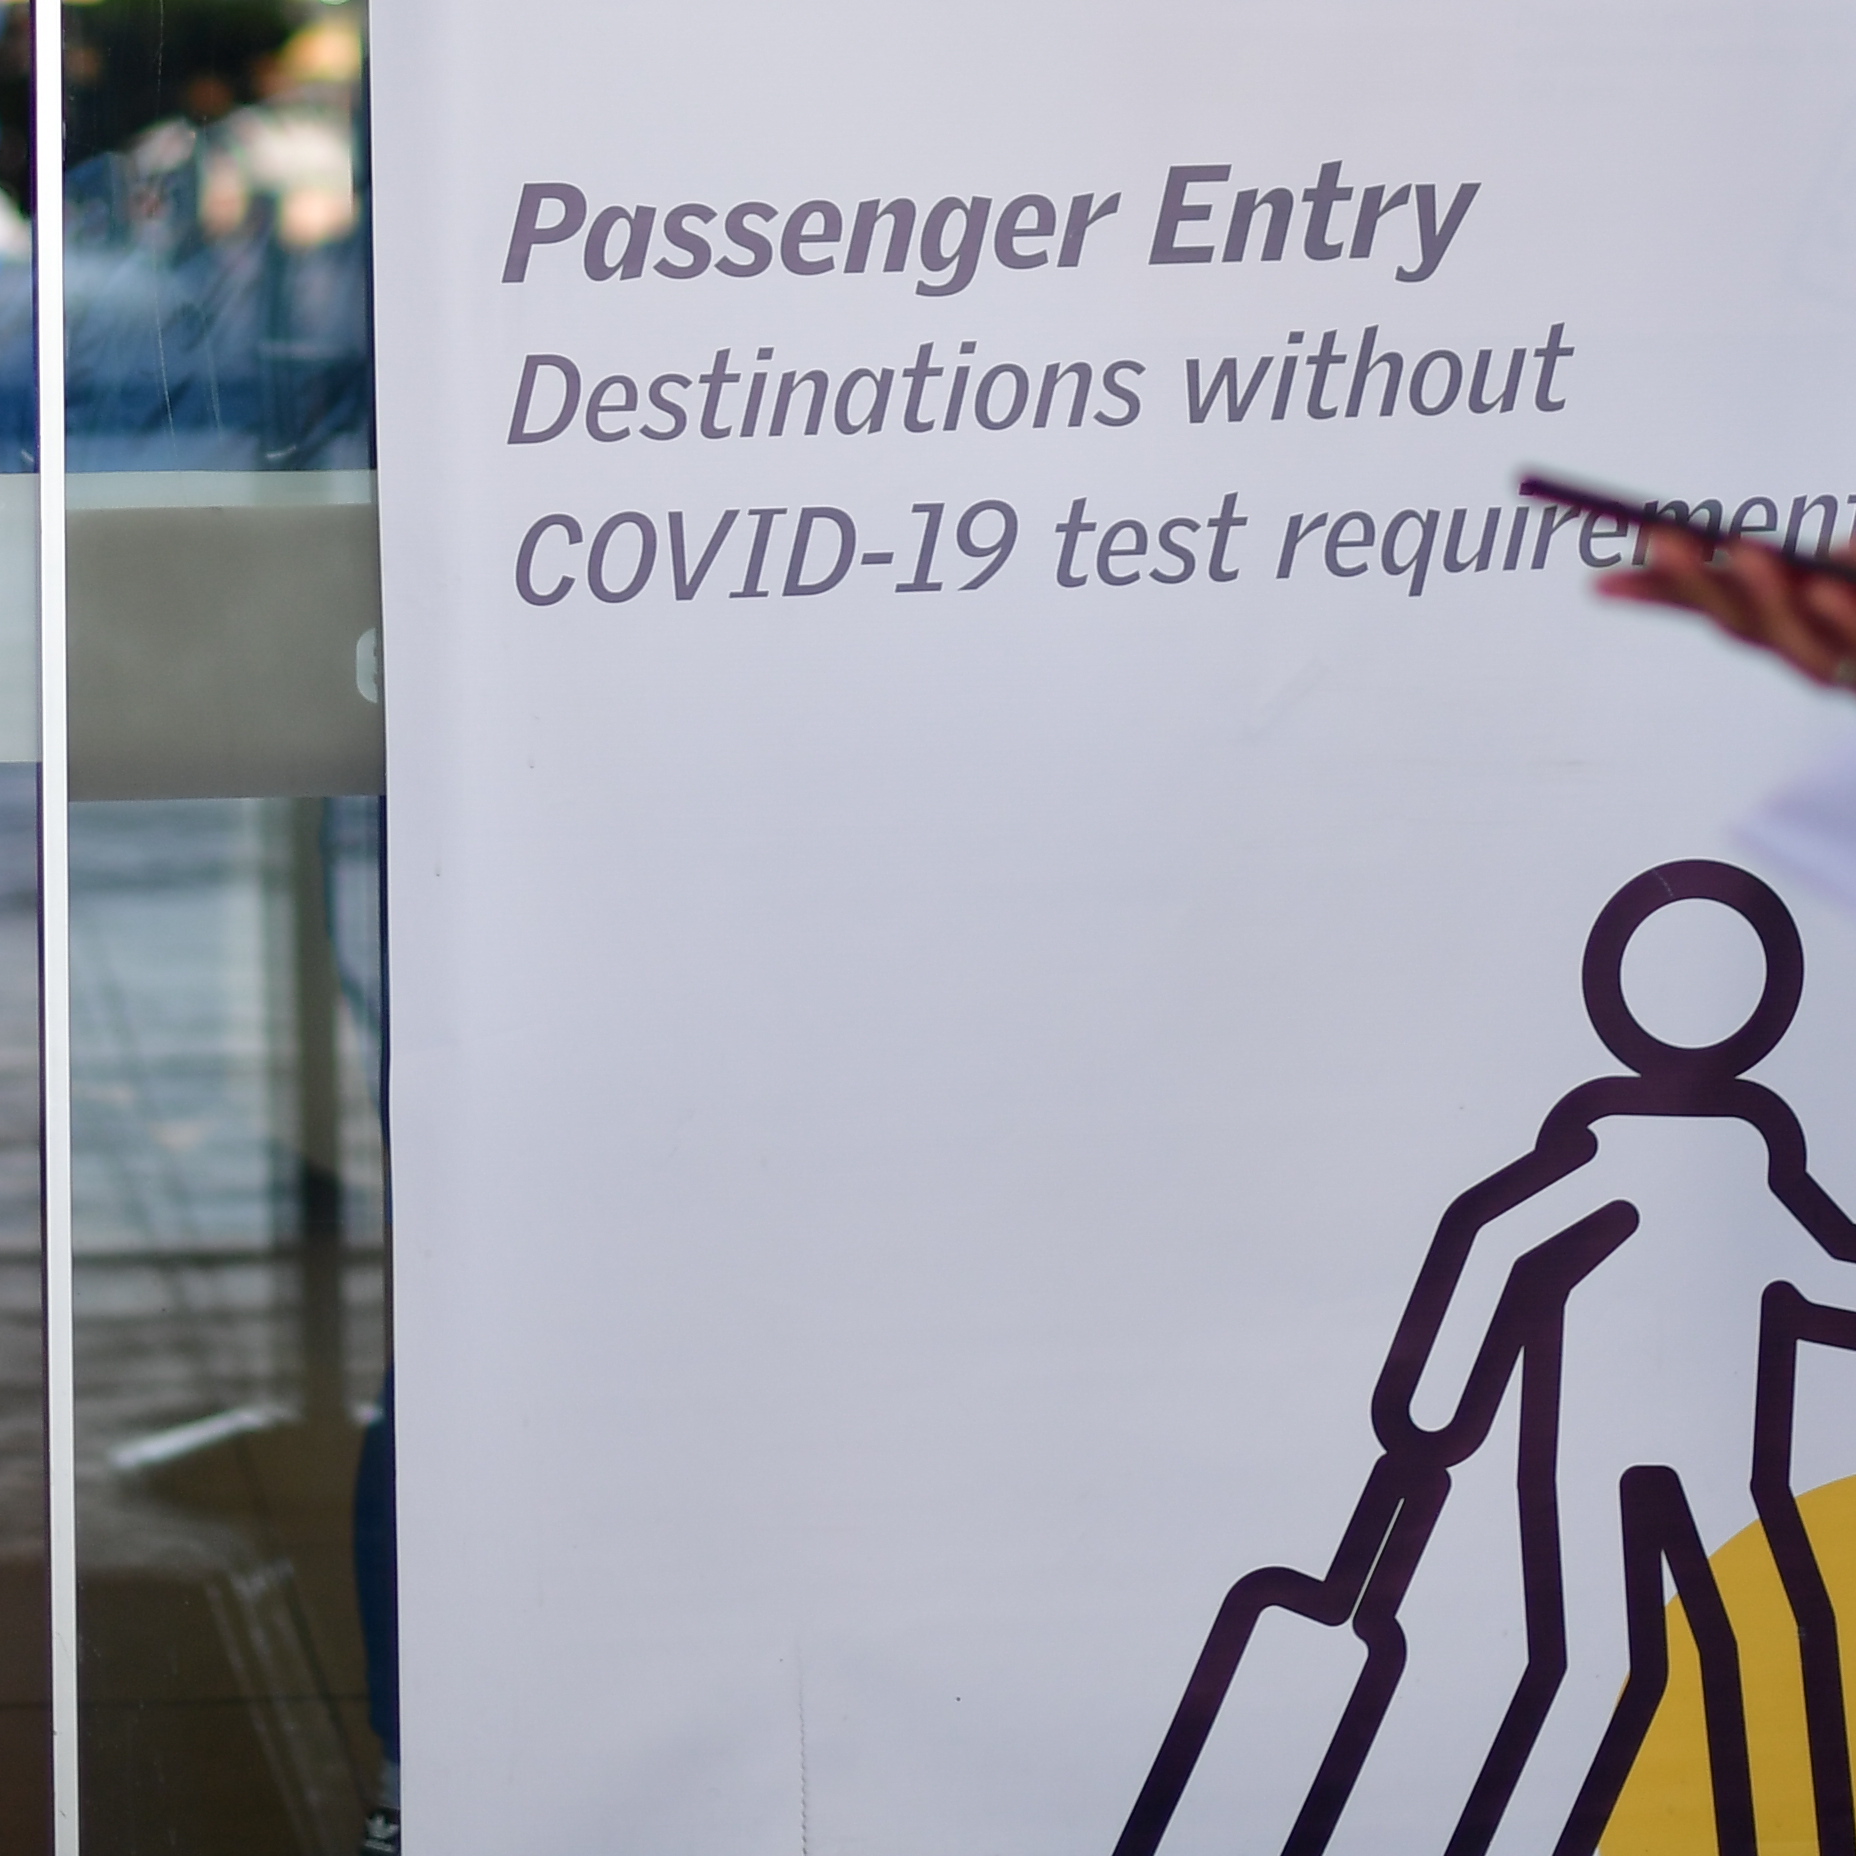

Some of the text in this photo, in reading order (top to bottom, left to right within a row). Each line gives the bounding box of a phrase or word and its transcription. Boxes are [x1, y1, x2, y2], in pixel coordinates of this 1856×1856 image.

[501, 160, 1482, 297] Passenger Entry
[506, 322, 1575, 445] Destinations without
[515, 499, 1018, 607] COVID-19
[1055, 491, 1248, 588] test
